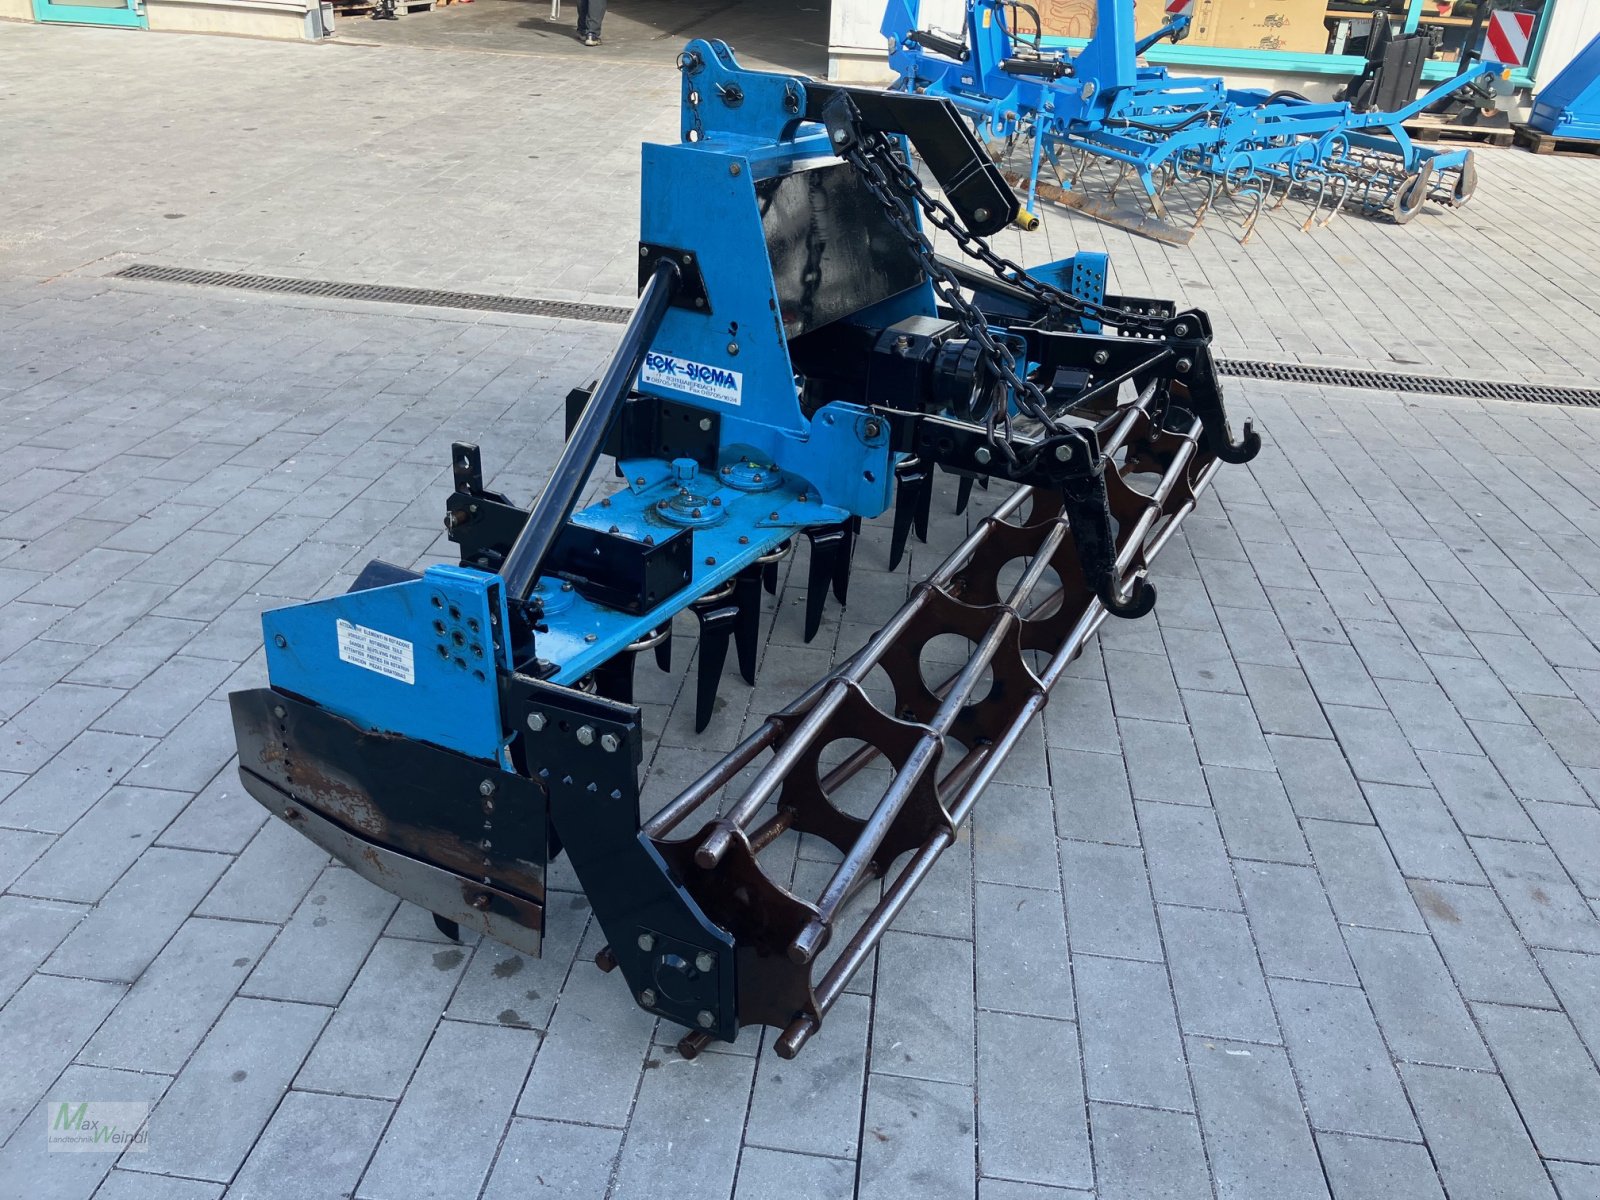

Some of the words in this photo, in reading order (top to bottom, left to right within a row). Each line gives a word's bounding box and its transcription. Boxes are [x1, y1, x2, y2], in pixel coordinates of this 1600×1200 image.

[689, 386, 700, 394] Fax
[389, 637, 410, 650] ROTAZIONE
[344, 645, 365, 657] ATTENTION
[390, 662, 410, 673] ROTATION
